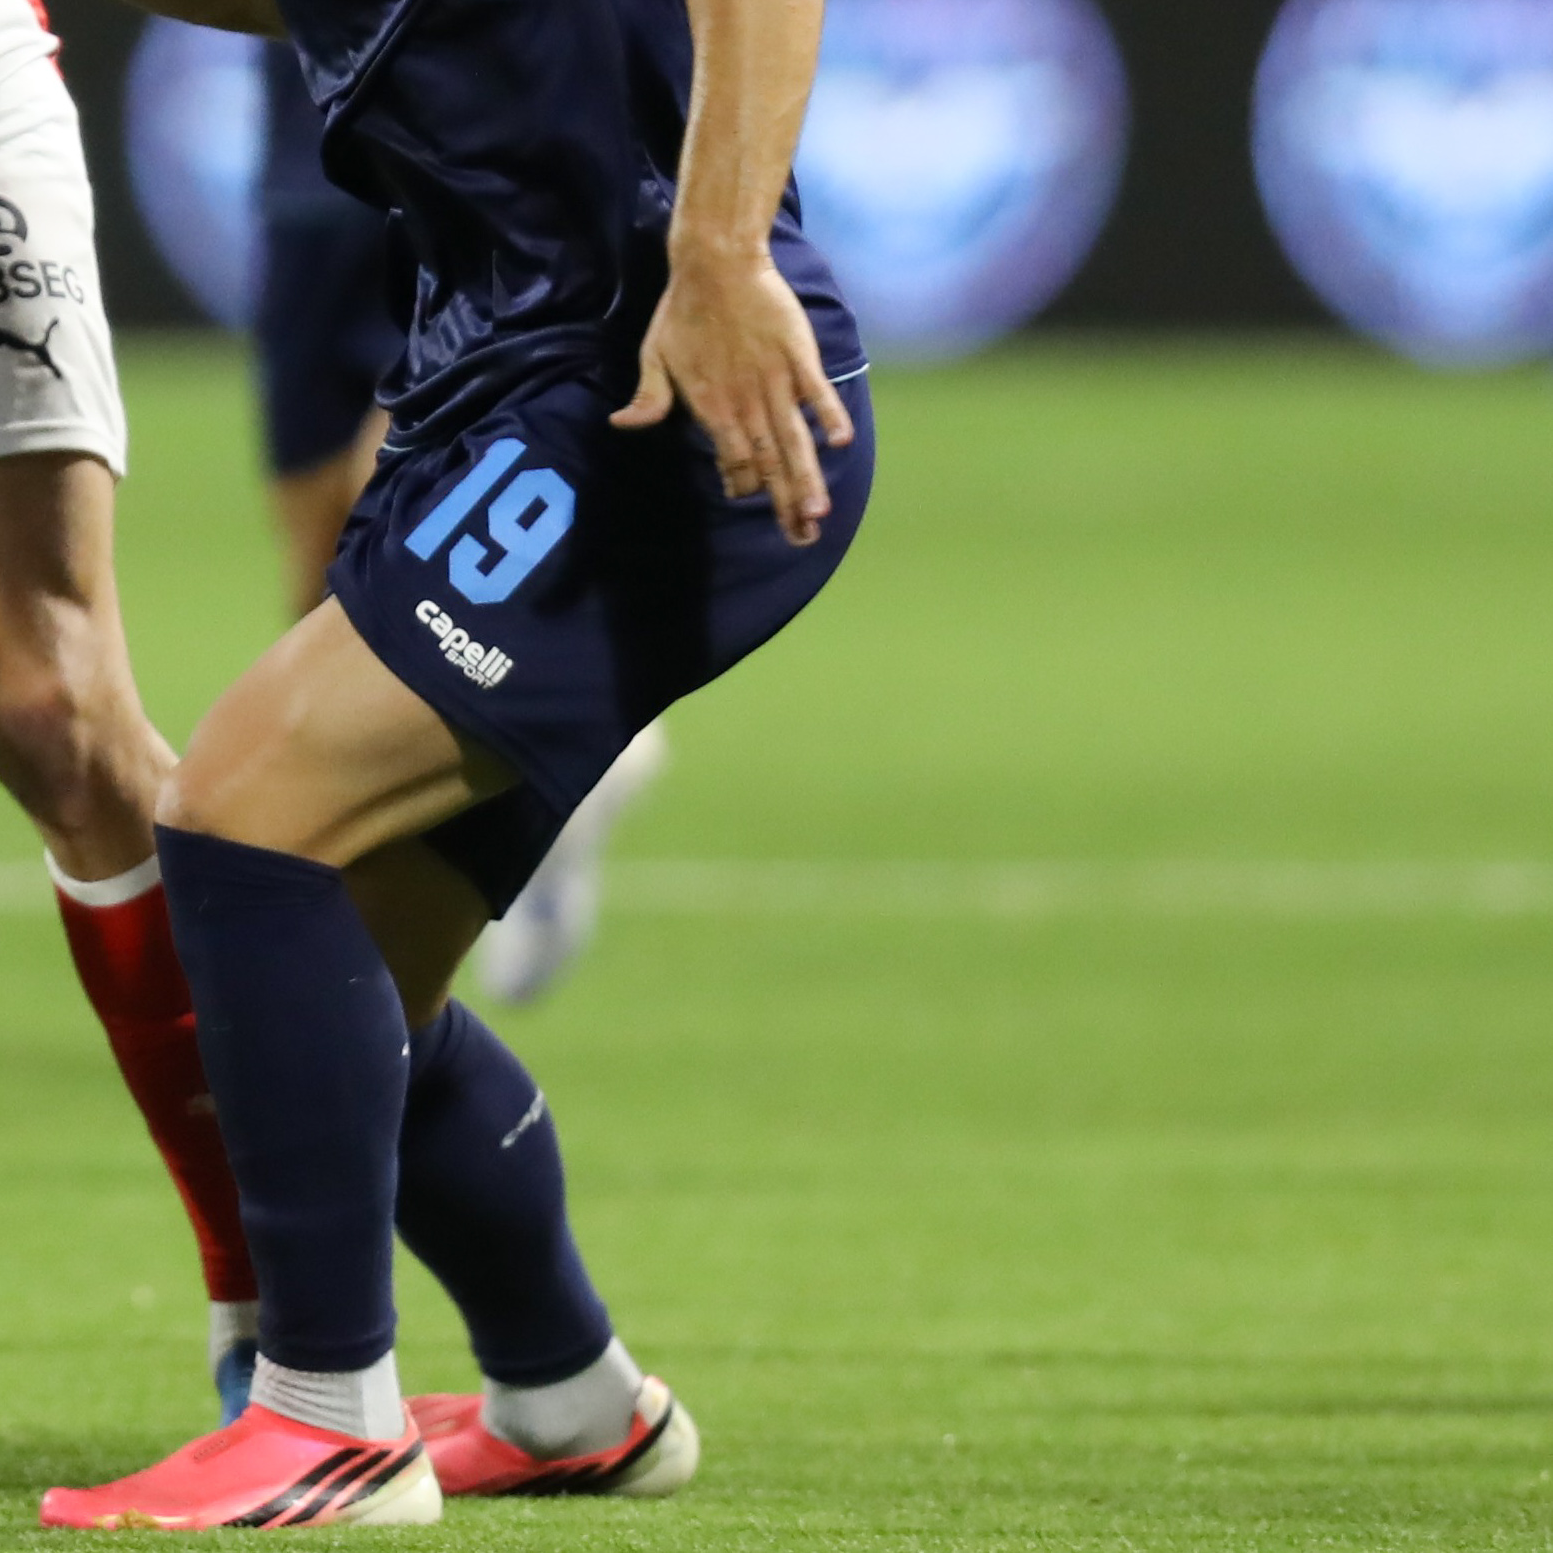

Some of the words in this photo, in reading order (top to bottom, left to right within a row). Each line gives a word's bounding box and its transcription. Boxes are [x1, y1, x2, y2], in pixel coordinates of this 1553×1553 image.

[403, 436, 577, 605] 19
[414, 599, 514, 684] capelli
[444, 649, 495, 690] SPORT
